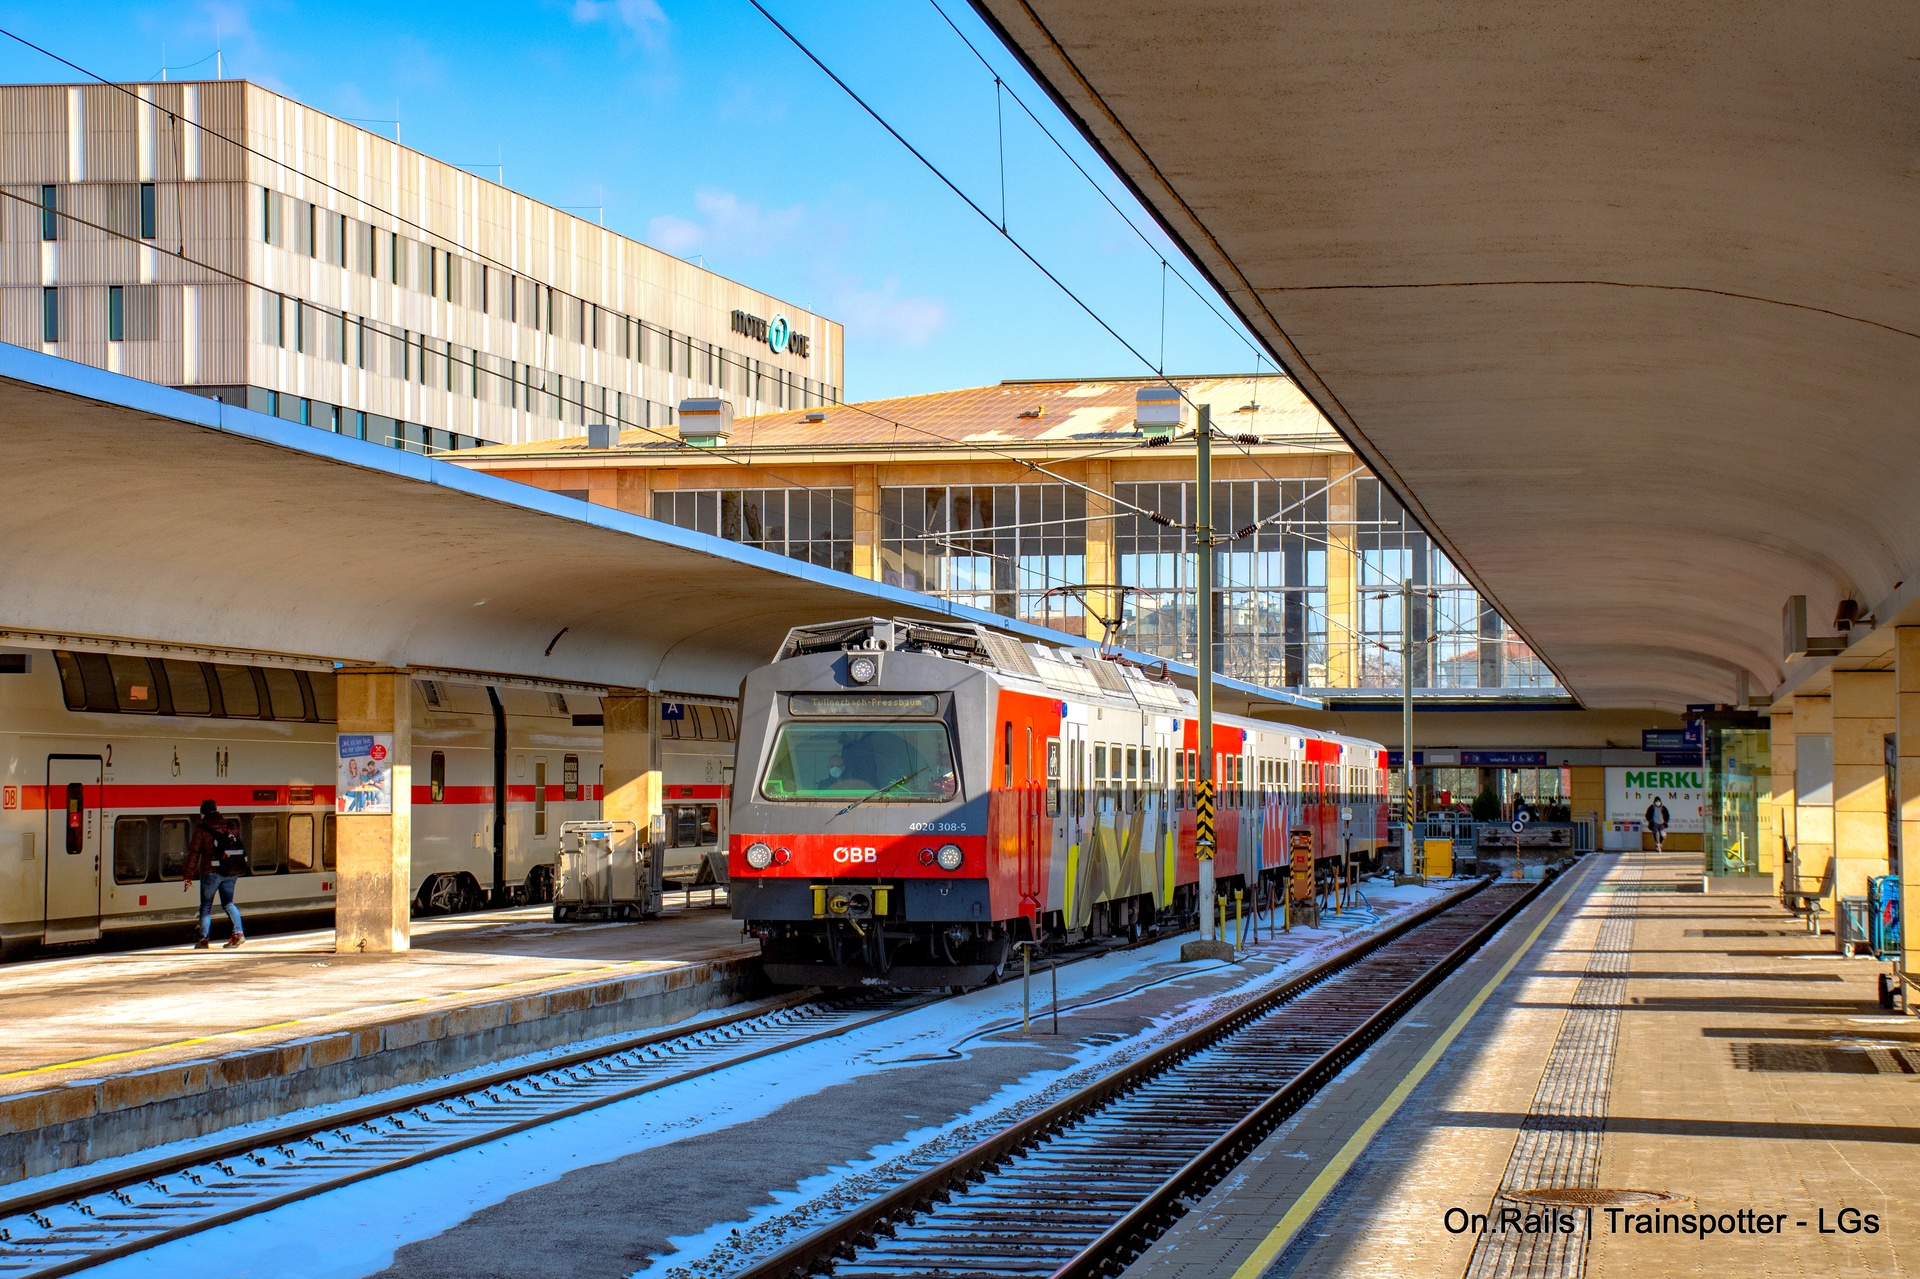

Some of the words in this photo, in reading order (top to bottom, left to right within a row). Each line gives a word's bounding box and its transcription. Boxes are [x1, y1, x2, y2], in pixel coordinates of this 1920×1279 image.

[731, 309, 769, 343] MOTEL
[788, 331, 809, 358] ONE
[667, 702, 679, 714] A
[812, 698, 922, 707] Tullnerbach-Pressbaum
[106, 744, 112, 767] 2
[1625, 771, 1705, 788] MERKU
[4, 788, 16, 807] DB
[909, 822, 935, 832] 4020
[938, 822, 967, 832] 308-5
[833, 846, 878, 863] ÖBB
